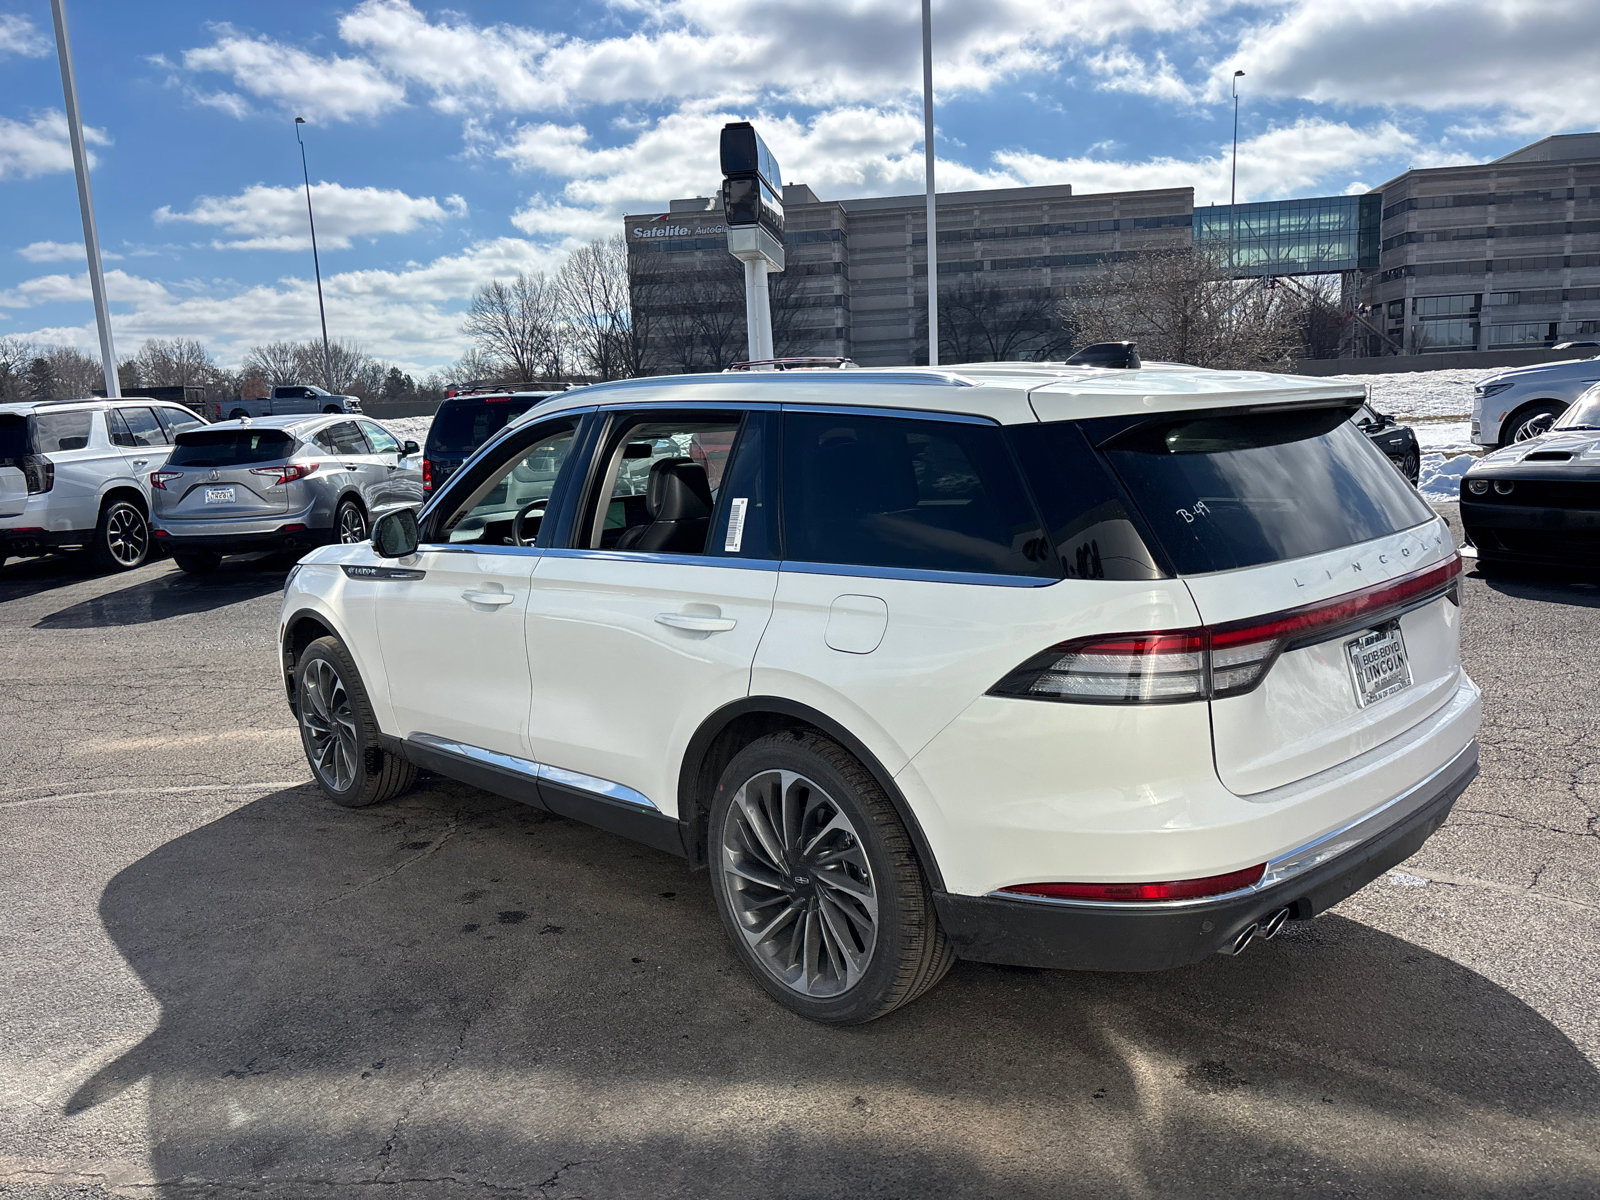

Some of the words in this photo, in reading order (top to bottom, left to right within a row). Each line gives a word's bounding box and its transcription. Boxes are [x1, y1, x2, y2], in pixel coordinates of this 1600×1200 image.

[633, 225, 689, 238] Safelite
[695, 225, 729, 235] AutoGla
[1176, 500, 1210, 523] B-49
[1293, 536, 1442, 588] LINCOLN
[1362, 641, 1400, 666] BOB-BOYD
[1364, 652, 1405, 683] LINCOLN
